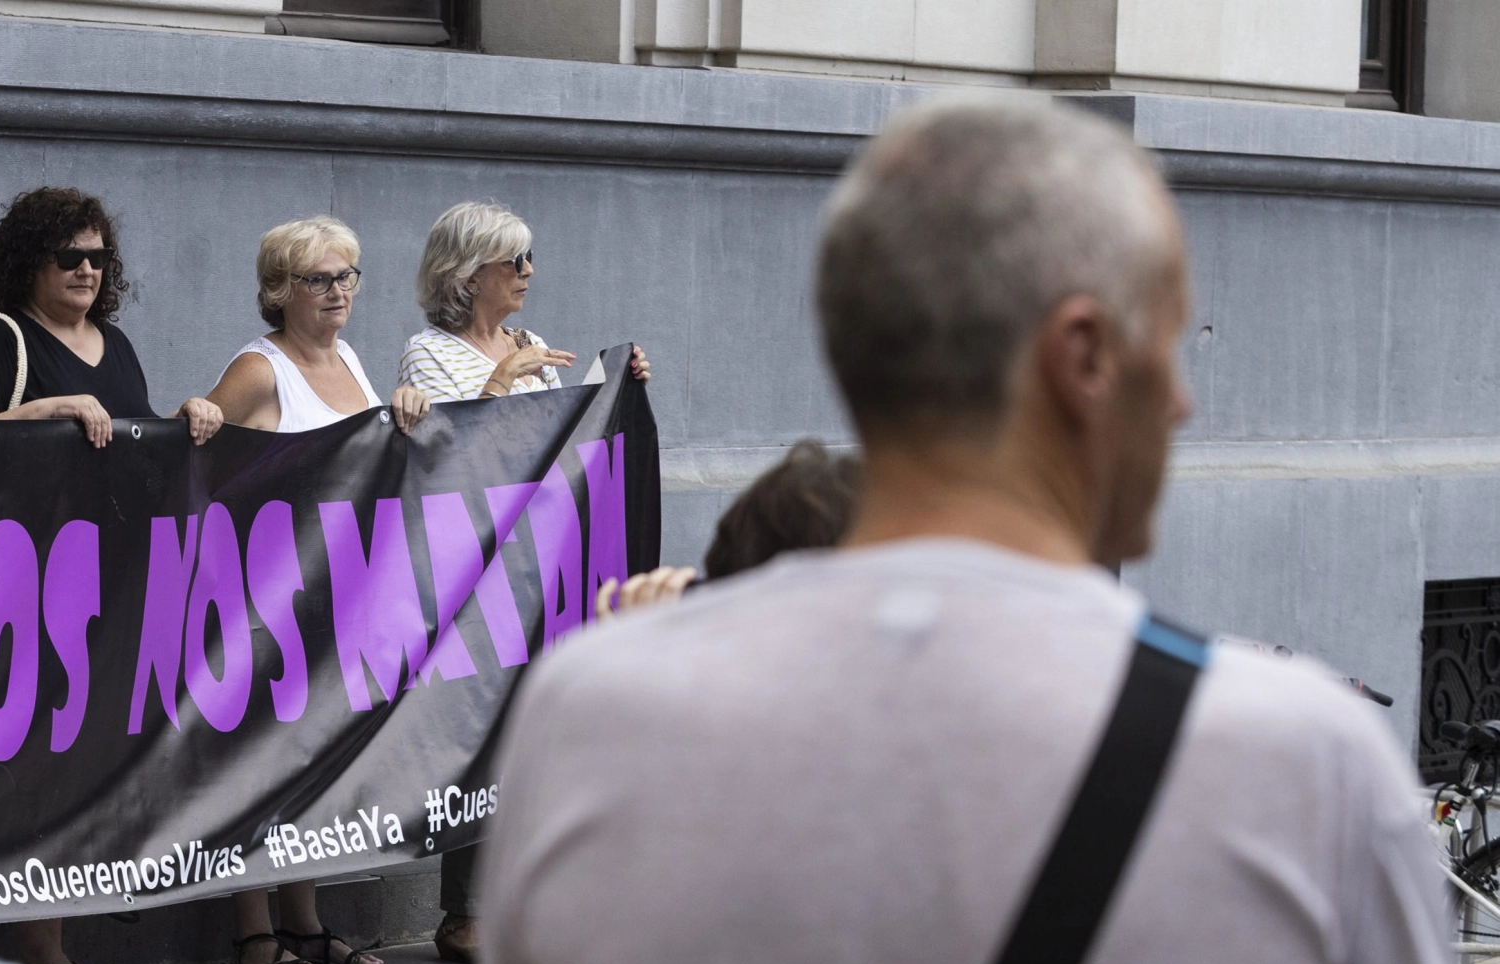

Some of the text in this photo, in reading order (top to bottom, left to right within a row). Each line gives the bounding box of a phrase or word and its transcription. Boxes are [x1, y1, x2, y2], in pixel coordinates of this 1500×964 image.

[127, 499, 309, 736] NOS
[317, 432, 629, 712] MATAN
[264, 805, 405, 868] #BastaYa
[424, 783, 500, 834] #Cues
